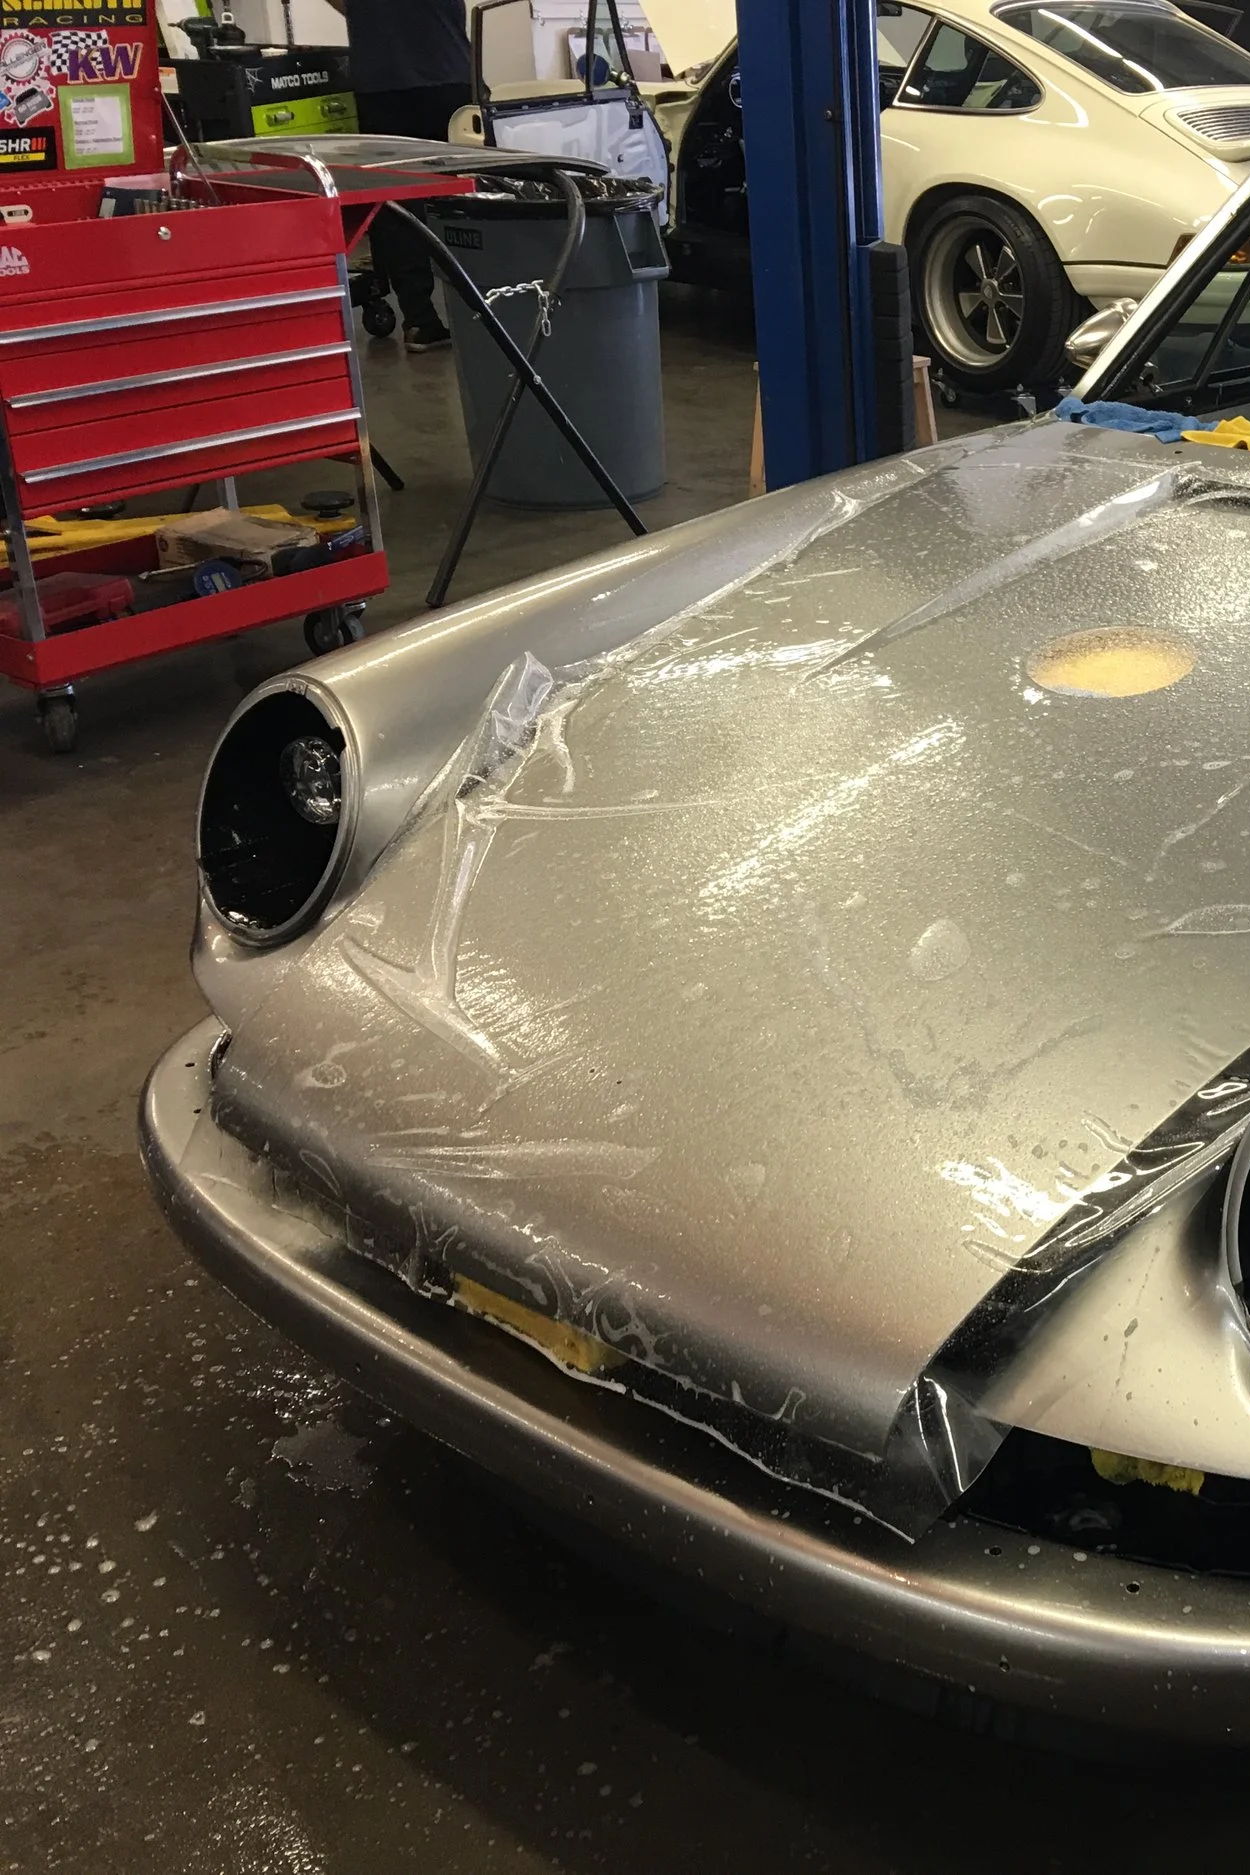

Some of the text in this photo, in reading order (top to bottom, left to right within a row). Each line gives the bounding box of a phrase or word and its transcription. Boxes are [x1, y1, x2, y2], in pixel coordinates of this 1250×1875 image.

[3, 13, 143, 26] RACING
[68, 43, 143, 84] KW
[271, 71, 329, 90] MATCO TOOLS
[446, 229, 481, 248] ULINE
[0, 246, 29, 269] AC
[0, 266, 31, 277] OOLS
